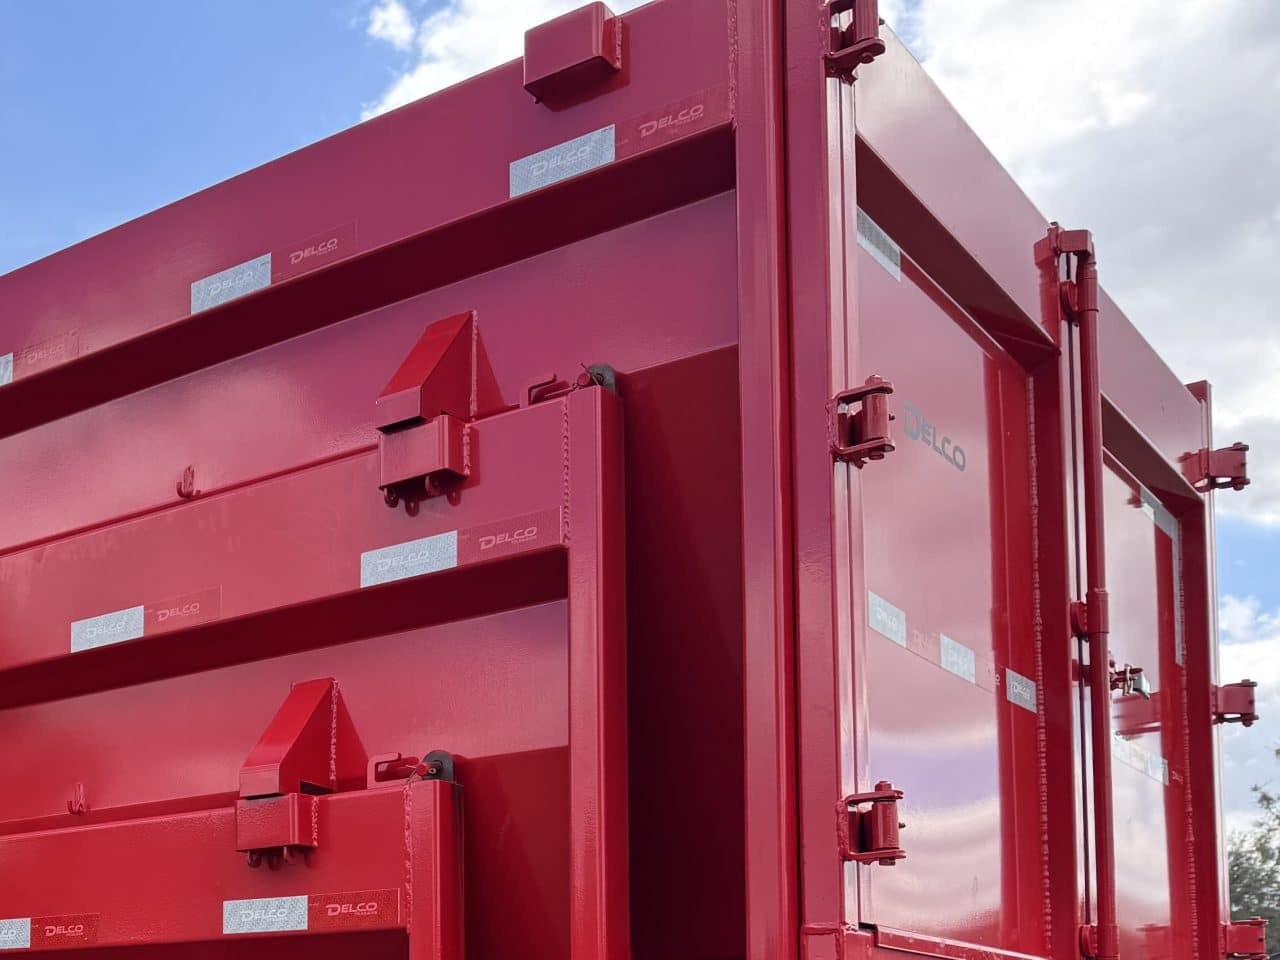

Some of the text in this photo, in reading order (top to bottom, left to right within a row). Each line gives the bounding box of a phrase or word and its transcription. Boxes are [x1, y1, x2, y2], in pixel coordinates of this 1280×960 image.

[639, 104, 705, 138] DELCO
[289, 238, 339, 265] DELCO
[901, 399, 966, 472] DELCO
[479, 526, 538, 550] DELCO
[157, 602, 200, 622] DELCO
[240, 908, 288, 923] DELCO
[326, 902, 378, 916] DELCO
[45, 924, 84, 937] DELCO
